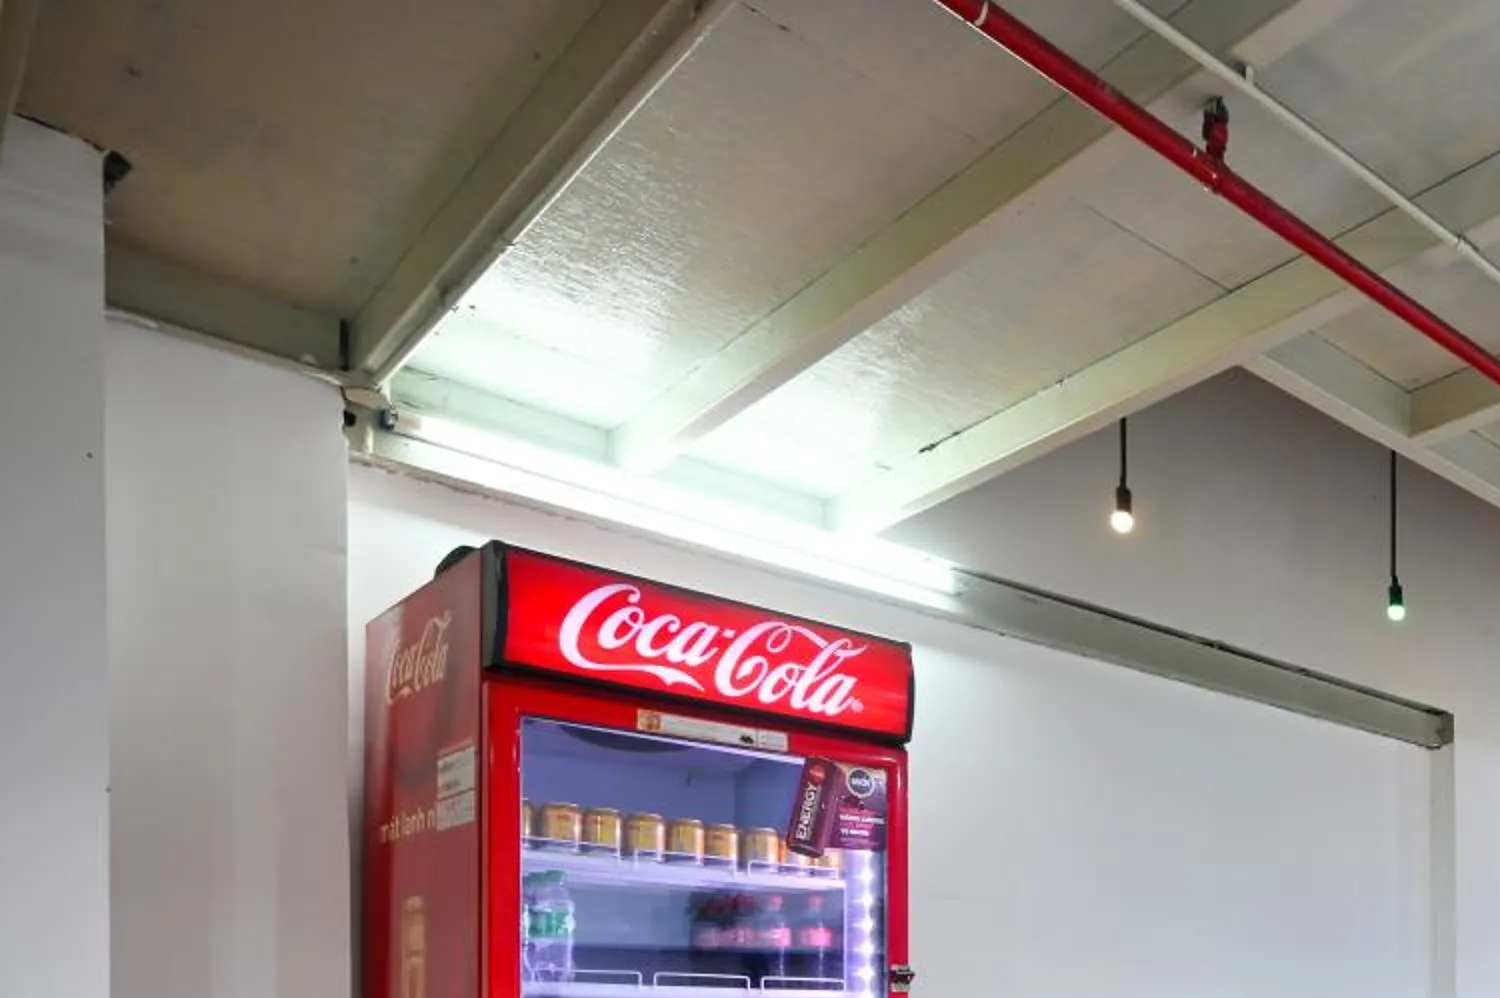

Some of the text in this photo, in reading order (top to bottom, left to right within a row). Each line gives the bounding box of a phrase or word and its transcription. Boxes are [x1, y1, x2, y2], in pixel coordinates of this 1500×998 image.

[386, 610, 452, 704] Coca-Cola
[559, 583, 867, 715] Coca-Cola
[795, 781, 817, 840] ENERGY
